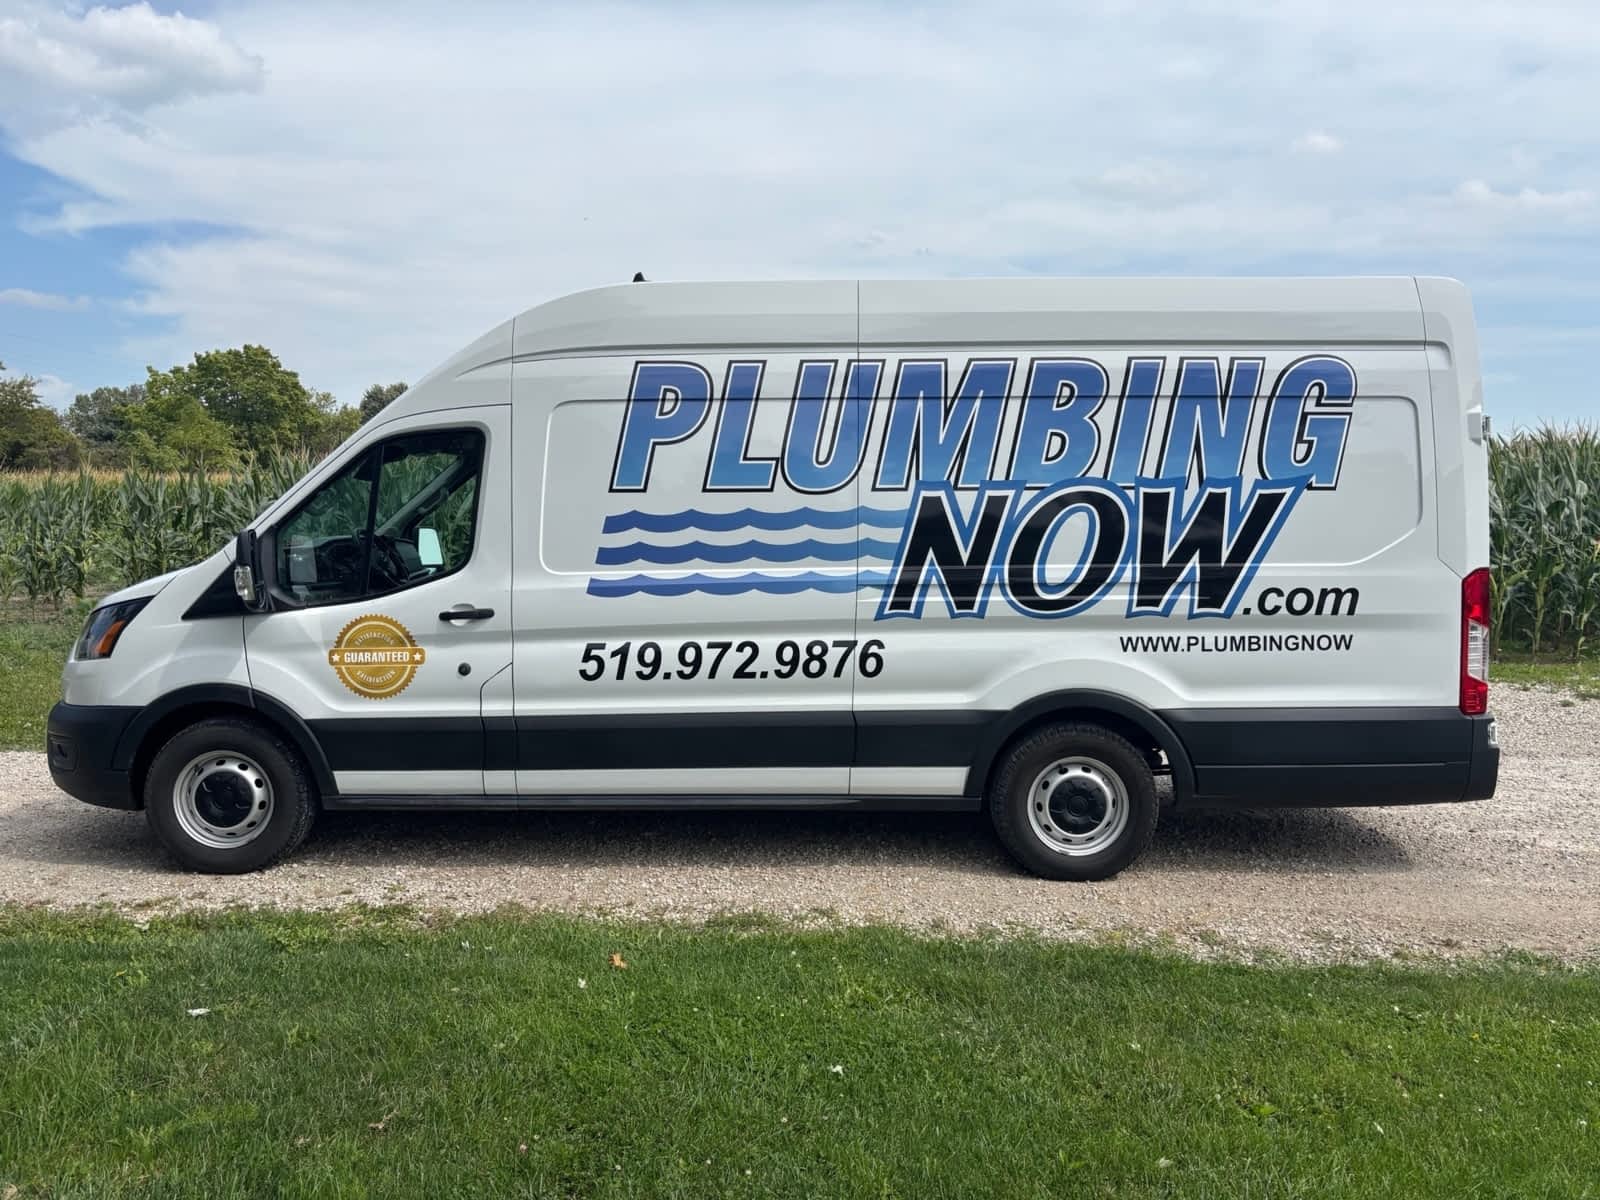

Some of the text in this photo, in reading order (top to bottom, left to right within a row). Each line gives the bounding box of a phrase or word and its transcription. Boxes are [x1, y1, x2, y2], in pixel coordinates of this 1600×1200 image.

[608, 355, 1357, 494] PLUMBING
[874, 474, 1359, 620] NOW .com
[344, 651, 410, 663] GUARANTEED
[578, 639, 886, 681] 519.972.9876
[1119, 635, 1353, 652] WWW.PLUMBINGNOW
